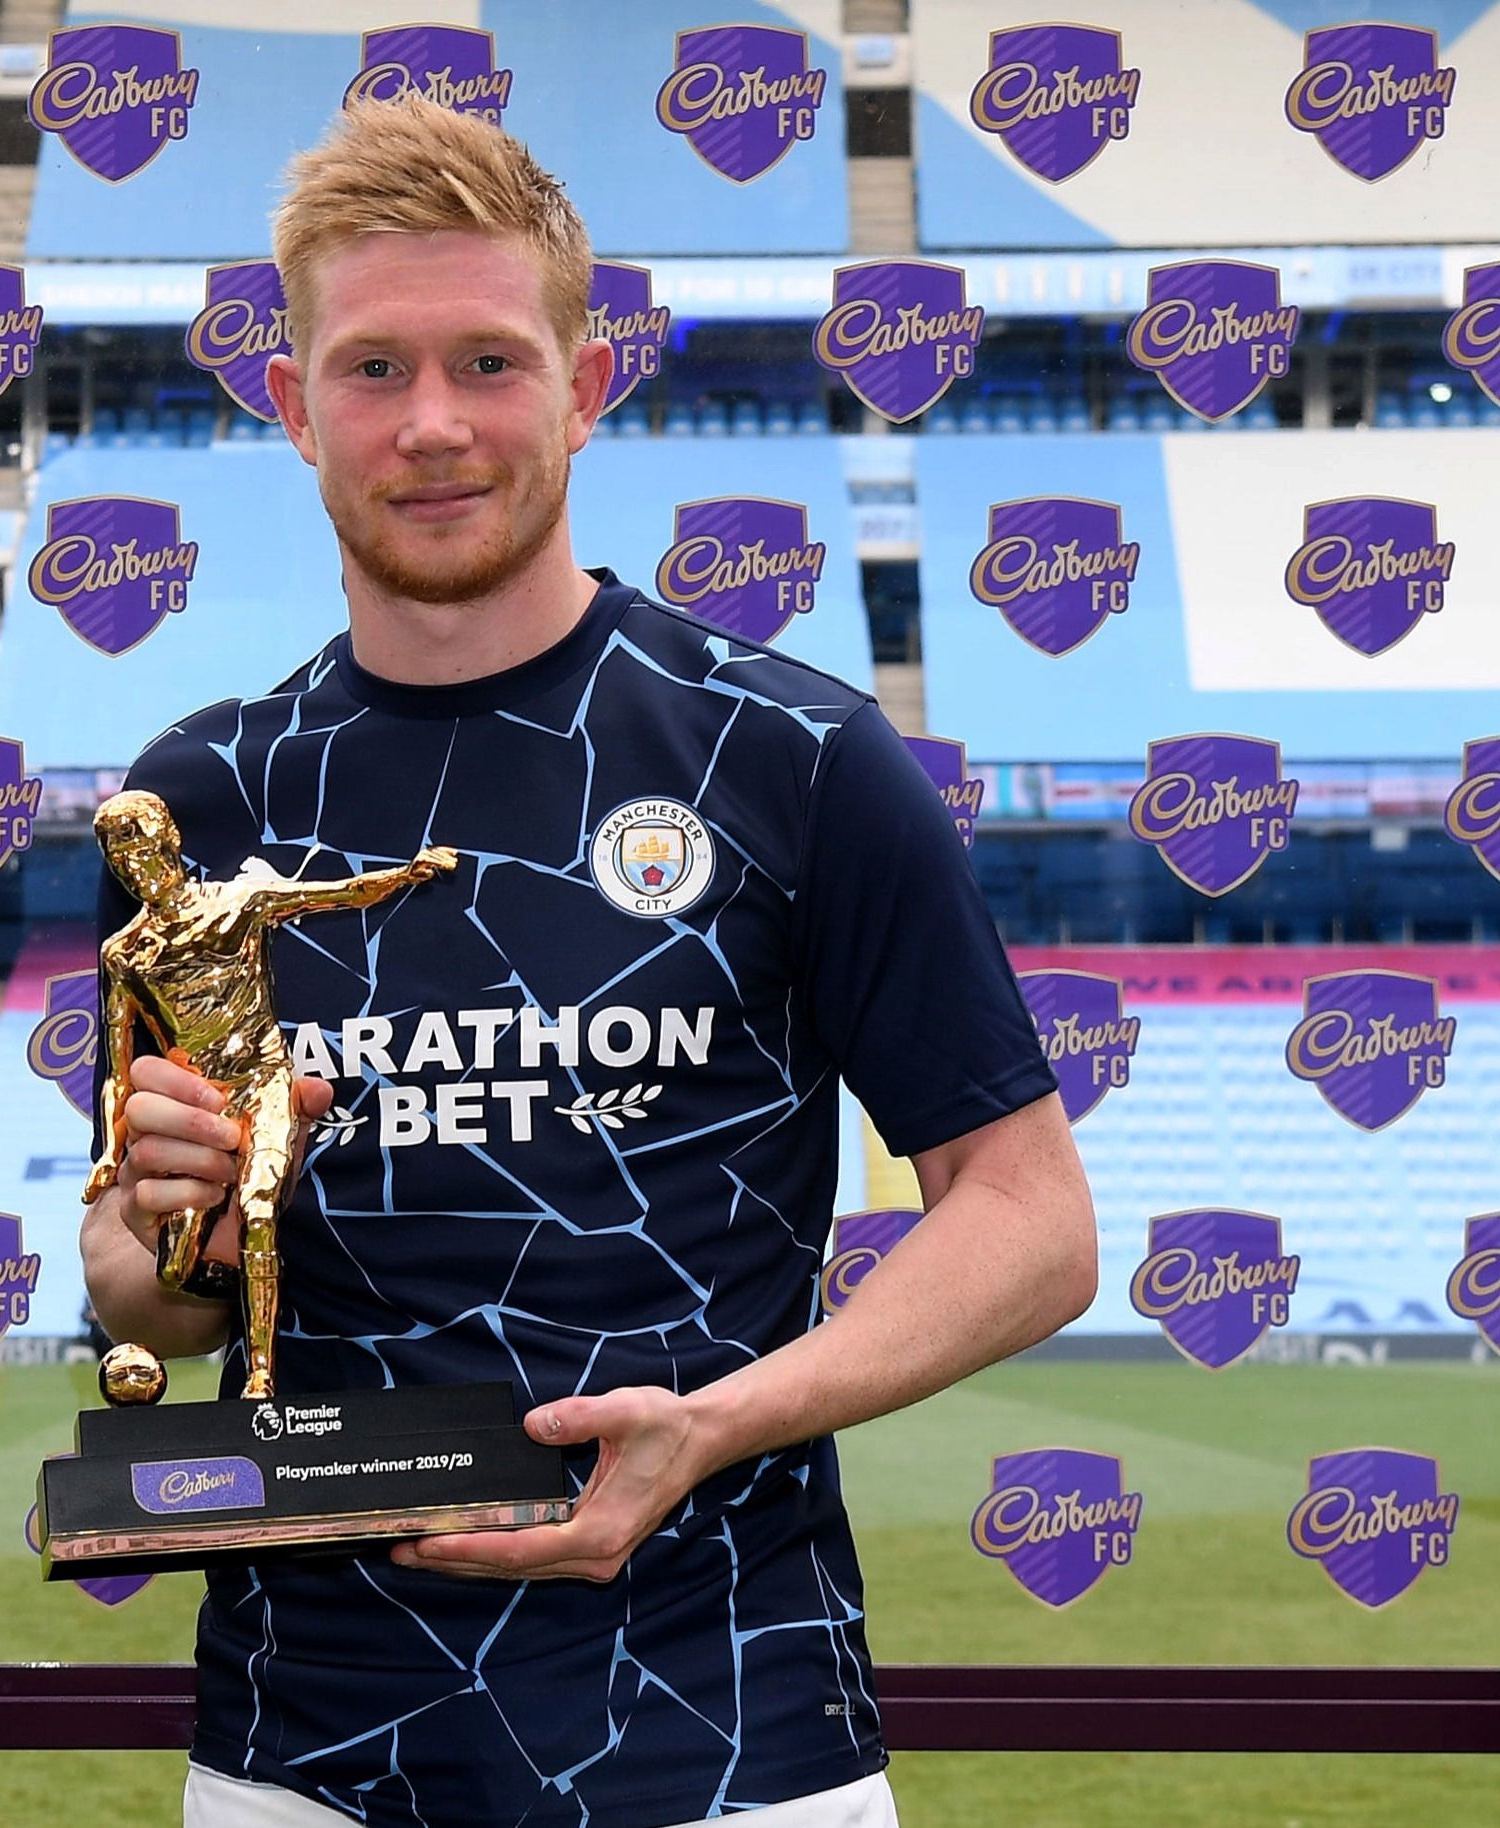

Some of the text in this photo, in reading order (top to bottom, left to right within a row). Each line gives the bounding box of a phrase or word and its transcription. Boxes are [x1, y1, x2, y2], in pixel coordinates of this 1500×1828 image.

[32, 62, 197, 129] Cadbury
[659, 63, 824, 130] Cadbury
[973, 62, 1138, 129] Cadbury
[1288, 62, 1453, 129] Cadbury
[151, 107, 185, 138] FC
[778, 108, 812, 139] FC
[1092, 107, 1126, 138] FC
[1407, 107, 1441, 138] FC
[817, 299, 982, 366] Cadbury
[1131, 299, 1296, 366] Cadbury
[622, 344, 656, 375] FC
[936, 344, 970, 375] FC
[1250, 344, 1284, 375] FC
[31, 535, 196, 602] Cadbury
[658, 536, 823, 603] Cadbury
[972, 536, 1137, 603] Cadbury
[1288, 536, 1453, 603] Cadbury
[150, 580, 184, 611] FC
[777, 581, 811, 612] FC
[1091, 581, 1125, 612] FC
[1407, 581, 1441, 612] FC
[1131, 773, 1296, 840] Cadbury
[602, 804, 703, 842] MANCHESTER
[1250, 818, 1284, 849] FC
[635, 899, 672, 911] CITY
[292, 1006, 715, 1080] ARATHON
[1036, 1013, 1138, 1060] dbury
[1289, 1010, 1454, 1077] Cadbury
[1092, 1055, 1126, 1086] FC
[1408, 1055, 1442, 1086] FC
[378, 1080, 549, 1147] BET
[1133, 1248, 1298, 1315] Cadbury
[1252, 1293, 1286, 1324] FC
[285, 1405, 341, 1421] Premier
[286, 1420, 342, 1436] League
[276, 1452, 473, 1481] Playmaker winner 2019/20
[160, 1470, 235, 1504] Cadbury
[975, 1486, 1140, 1553] Cadbury
[1291, 1487, 1456, 1554] Cadbury
[1094, 1531, 1128, 1562] FC
[1410, 1532, 1444, 1563] FC
